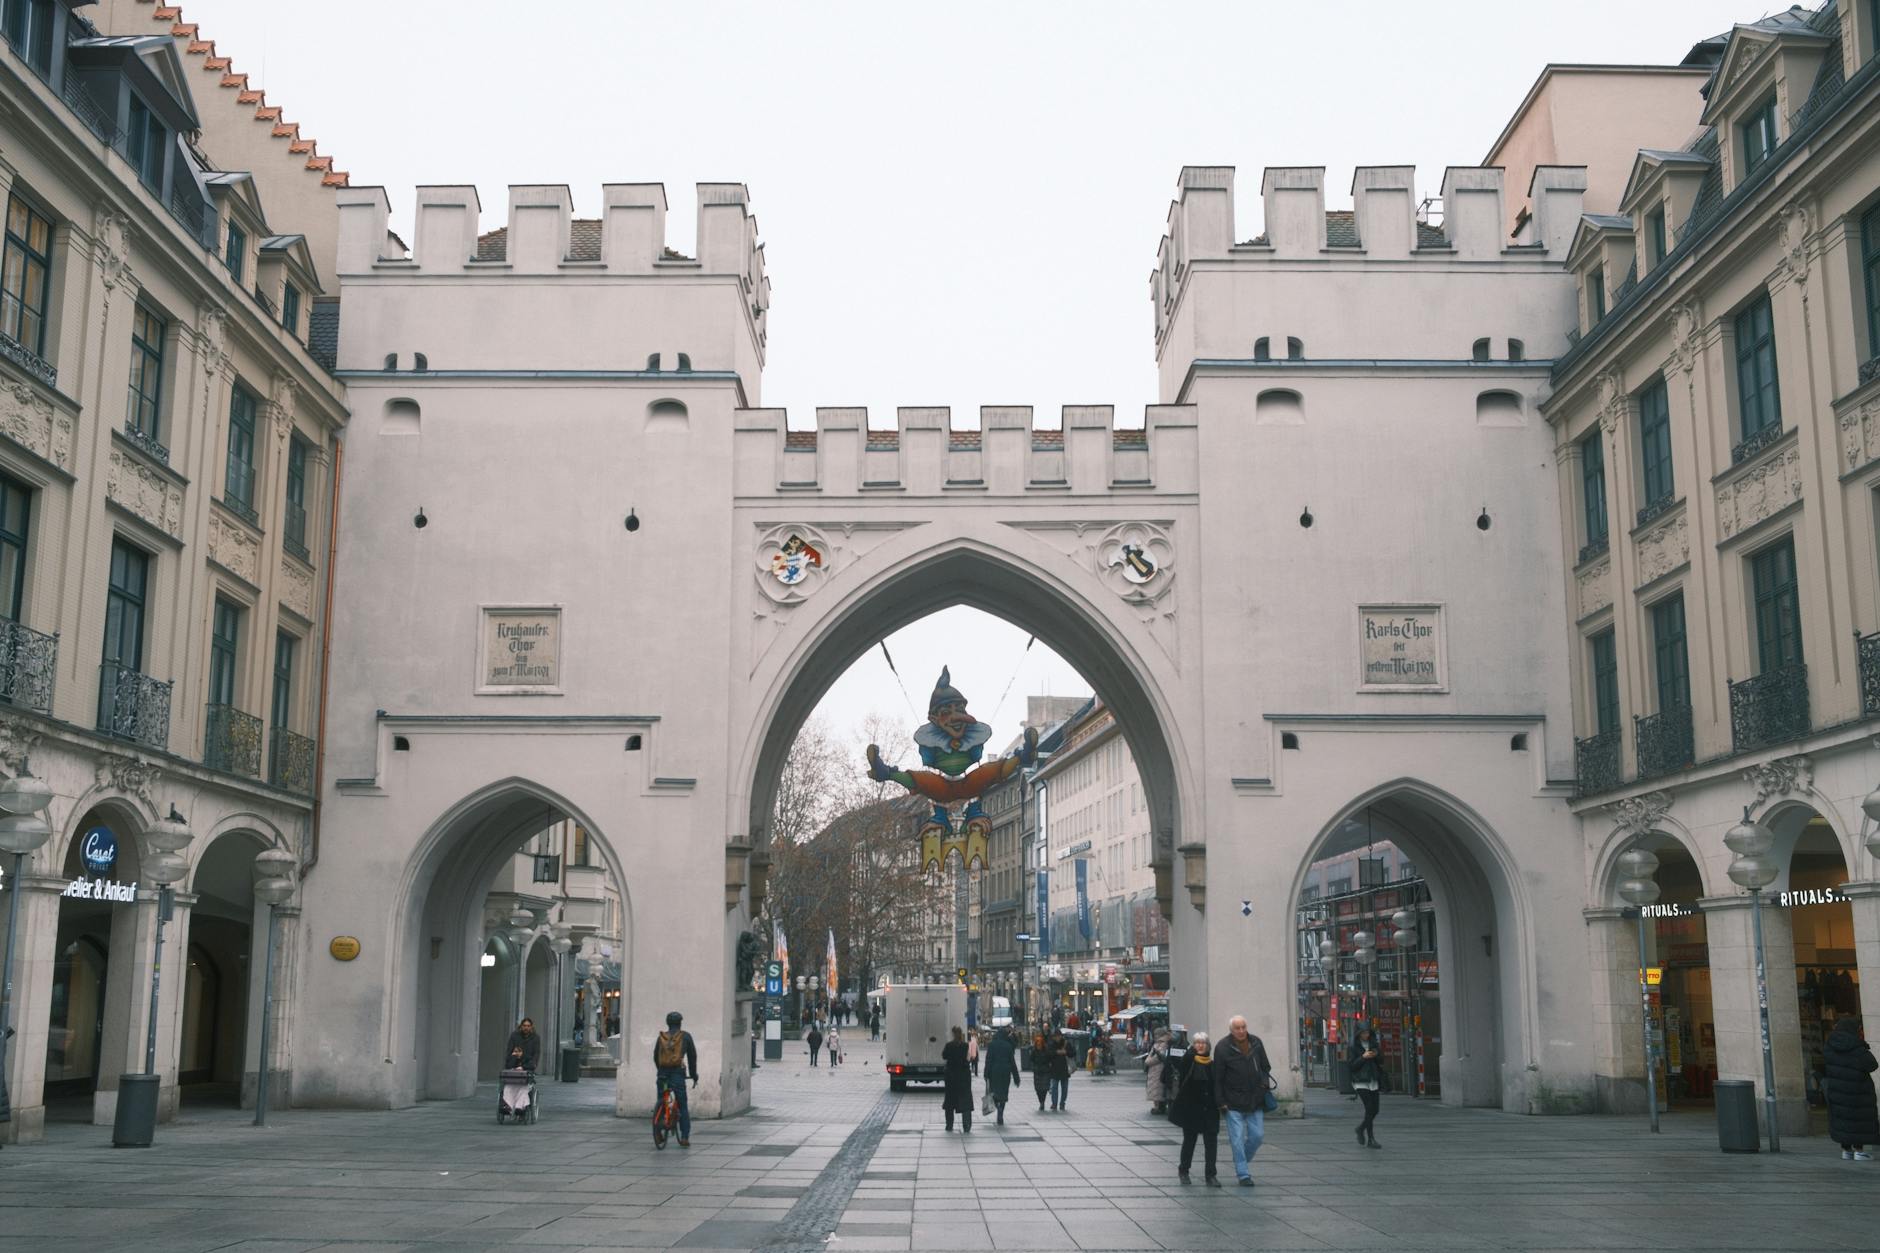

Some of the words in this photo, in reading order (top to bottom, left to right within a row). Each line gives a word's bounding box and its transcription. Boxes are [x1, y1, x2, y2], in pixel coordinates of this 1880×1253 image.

[1366, 618, 1400, 639] Karls
[1401, 617, 1433, 640] Thor
[508, 636, 536, 653] Thor
[514, 663, 534, 676] Mai
[1390, 657, 1415, 675] Mai
[93, 878, 103, 900] &
[103, 879, 137, 903] Ankauf
[769, 964, 780, 977] S
[769, 980, 779, 992] U
